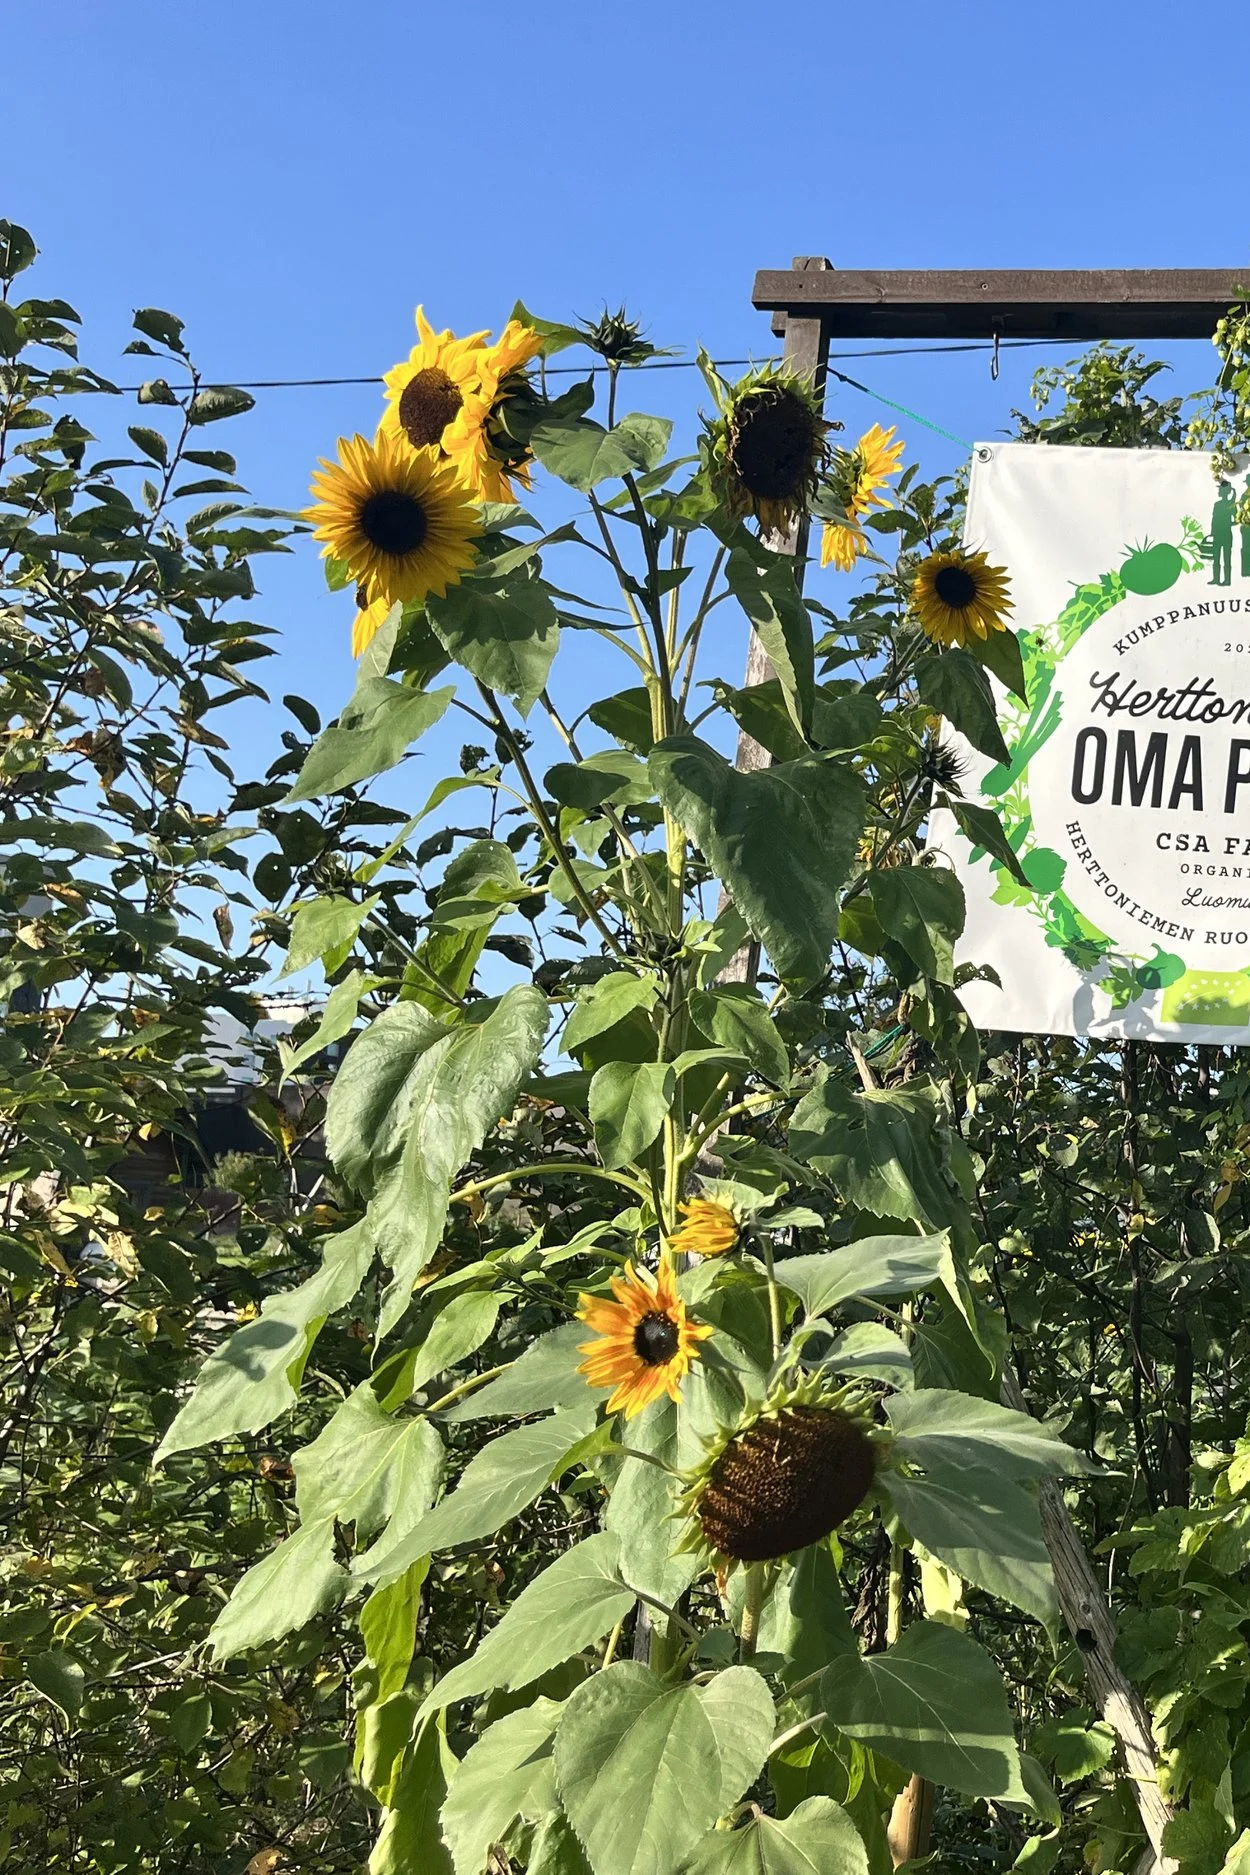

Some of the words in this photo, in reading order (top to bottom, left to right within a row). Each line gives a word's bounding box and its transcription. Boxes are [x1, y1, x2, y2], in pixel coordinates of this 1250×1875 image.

[1070, 725, 1205, 812] OMA
[1065, 820, 1195, 943] HERTTONIEMEN
[1155, 832, 1210, 854] CSA
